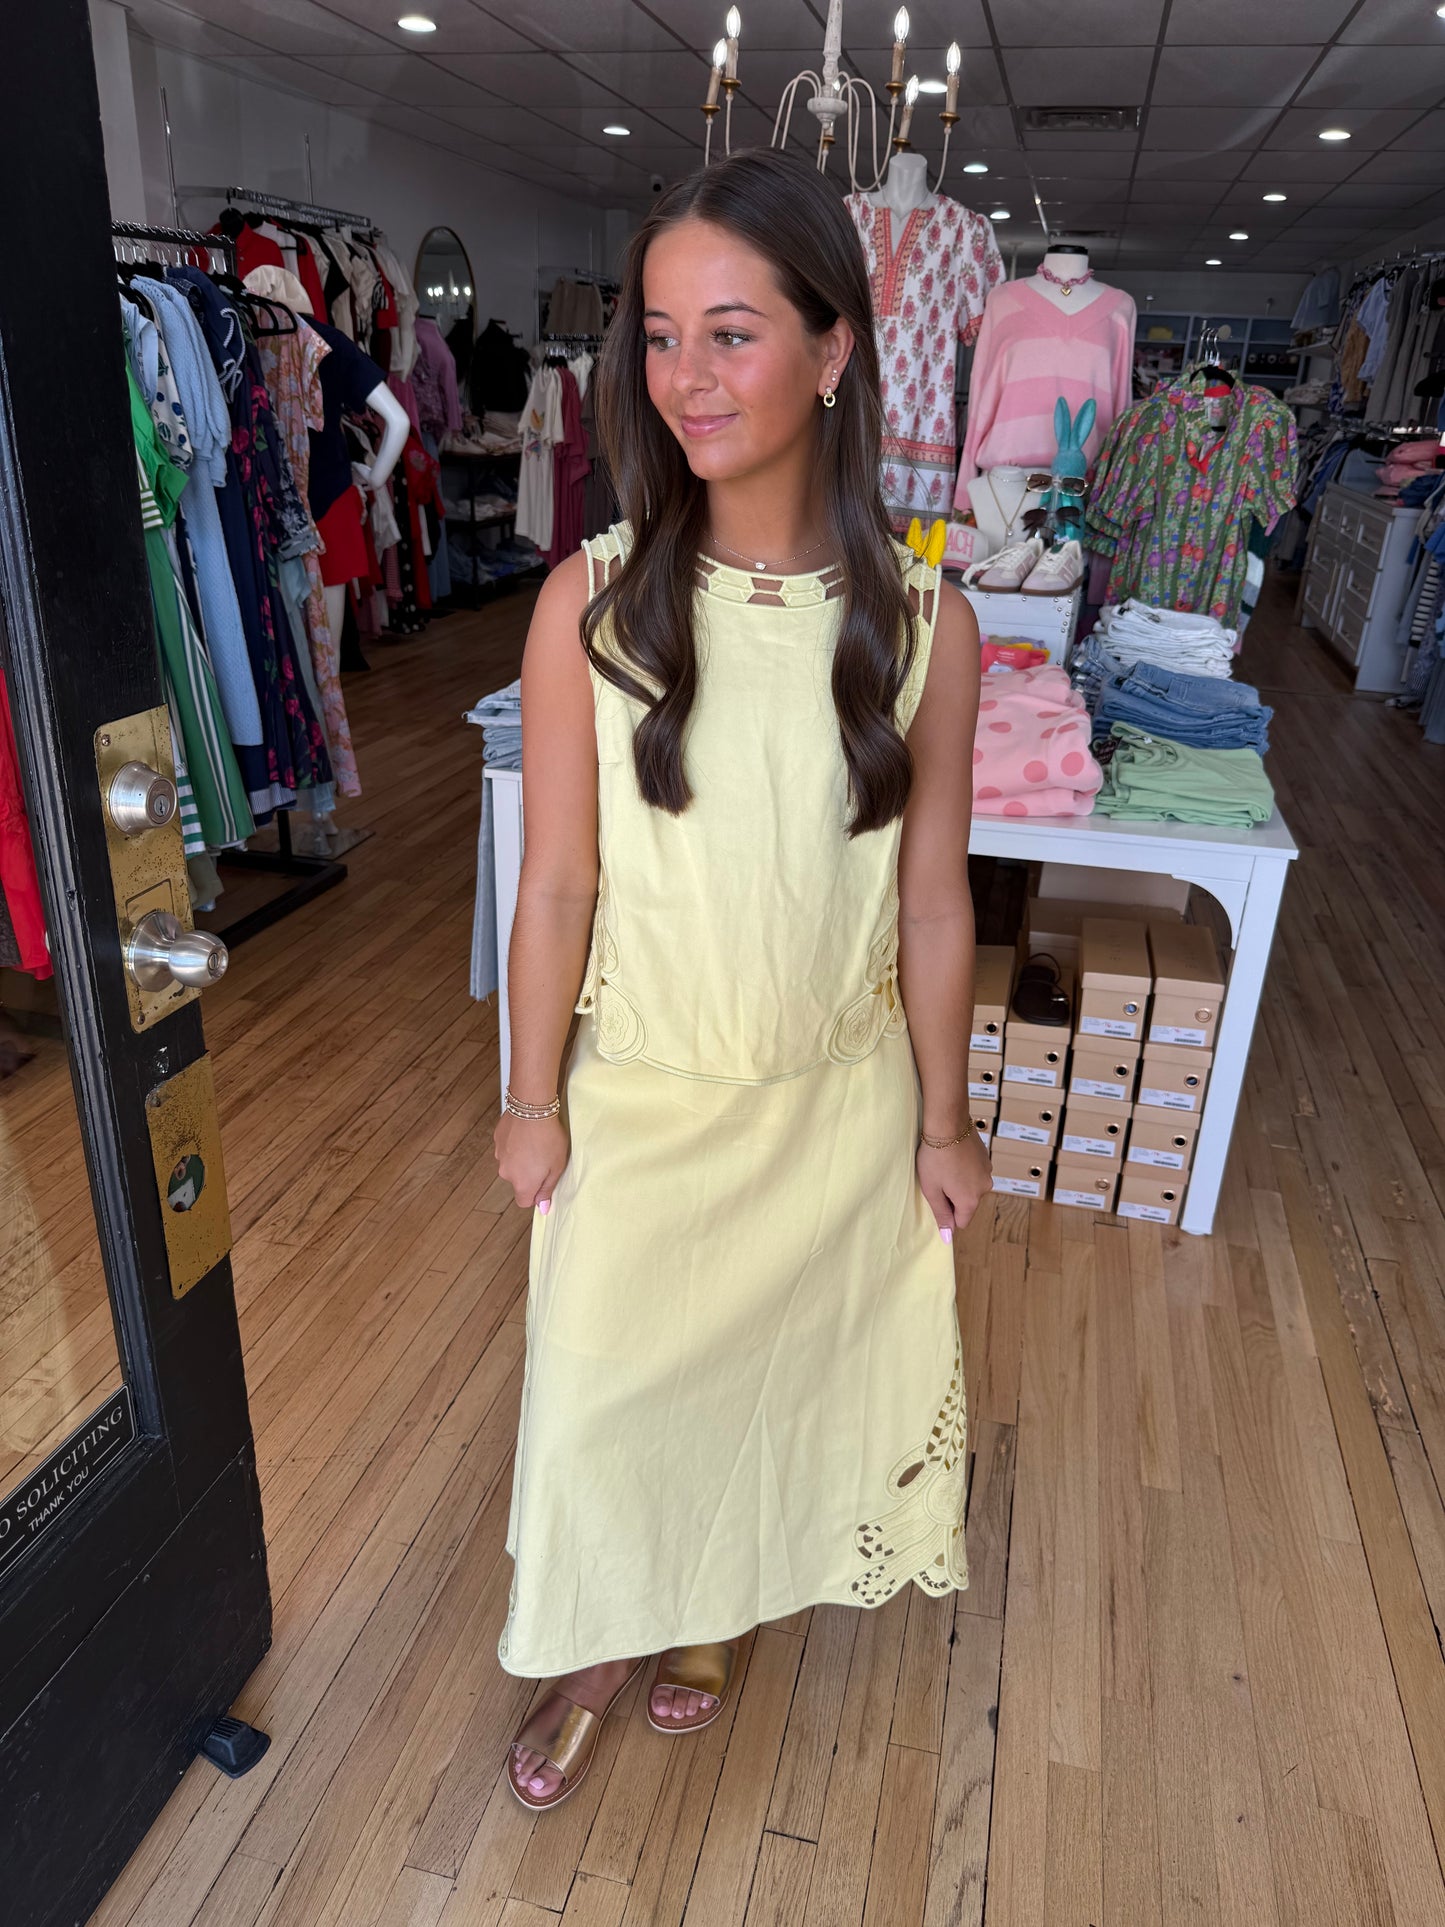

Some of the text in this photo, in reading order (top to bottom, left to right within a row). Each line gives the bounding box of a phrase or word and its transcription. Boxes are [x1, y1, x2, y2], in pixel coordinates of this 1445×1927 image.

[944, 528, 975, 559] ACH
[0, 1406, 123, 1539] O SOLICITING
[28, 1466, 89, 1532] THANK YOU
